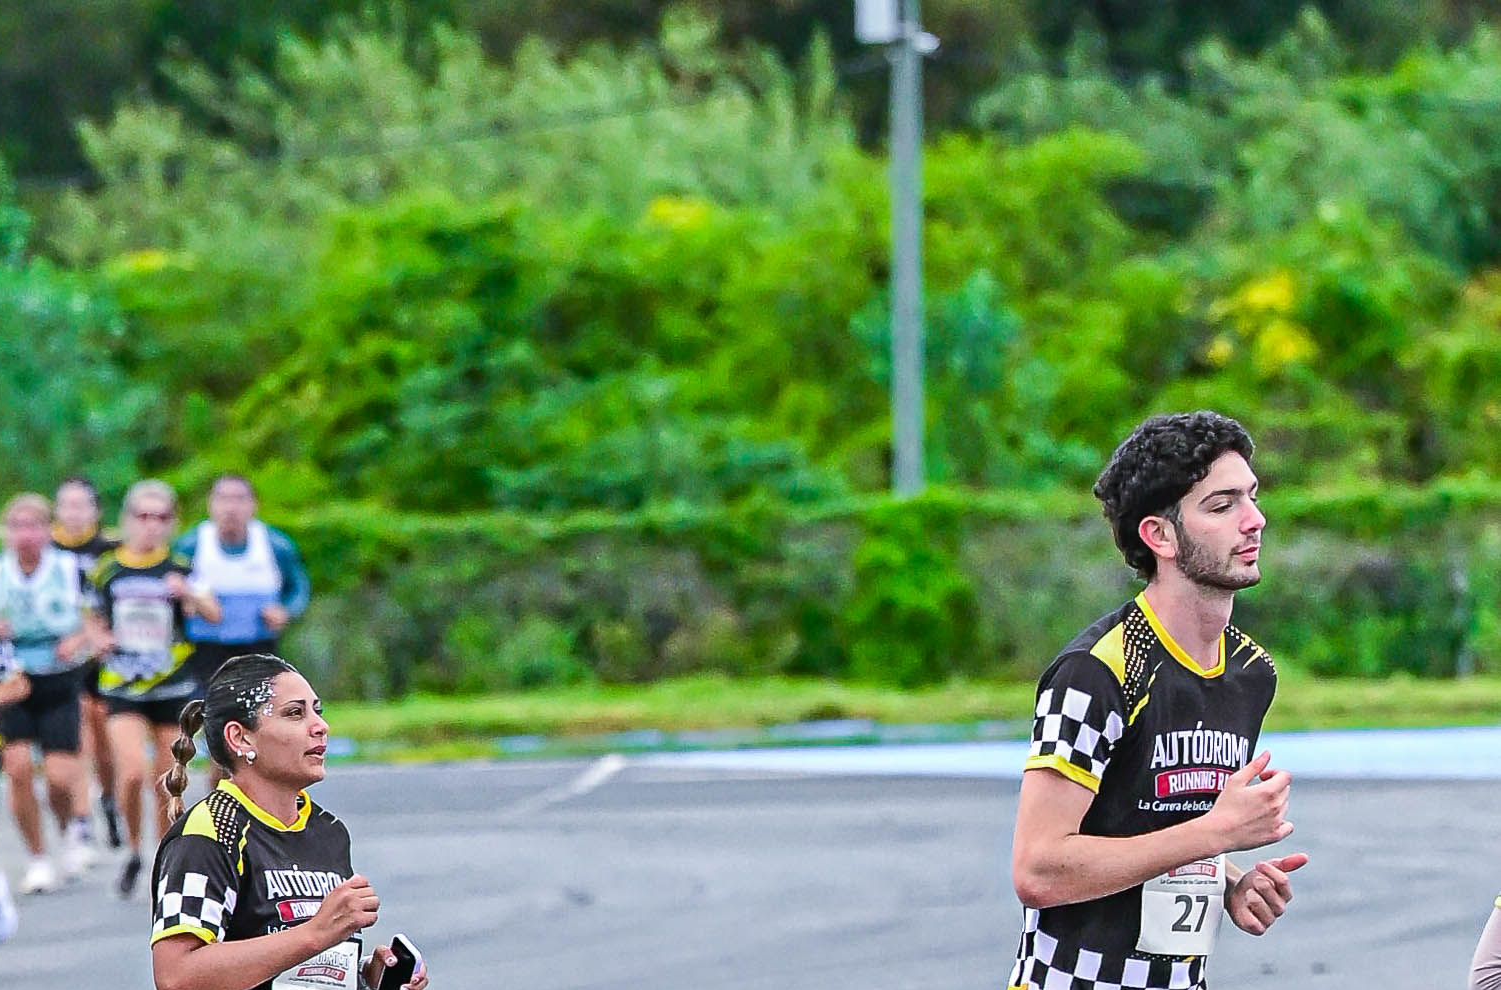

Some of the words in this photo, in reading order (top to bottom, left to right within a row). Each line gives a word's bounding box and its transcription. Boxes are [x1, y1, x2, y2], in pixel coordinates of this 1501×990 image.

[1150, 720, 1250, 770] AUTÓDROMO
[1138, 799, 1150, 810] La
[264, 863, 347, 900] AUTÓDRO
[1171, 895, 1209, 933] 27
